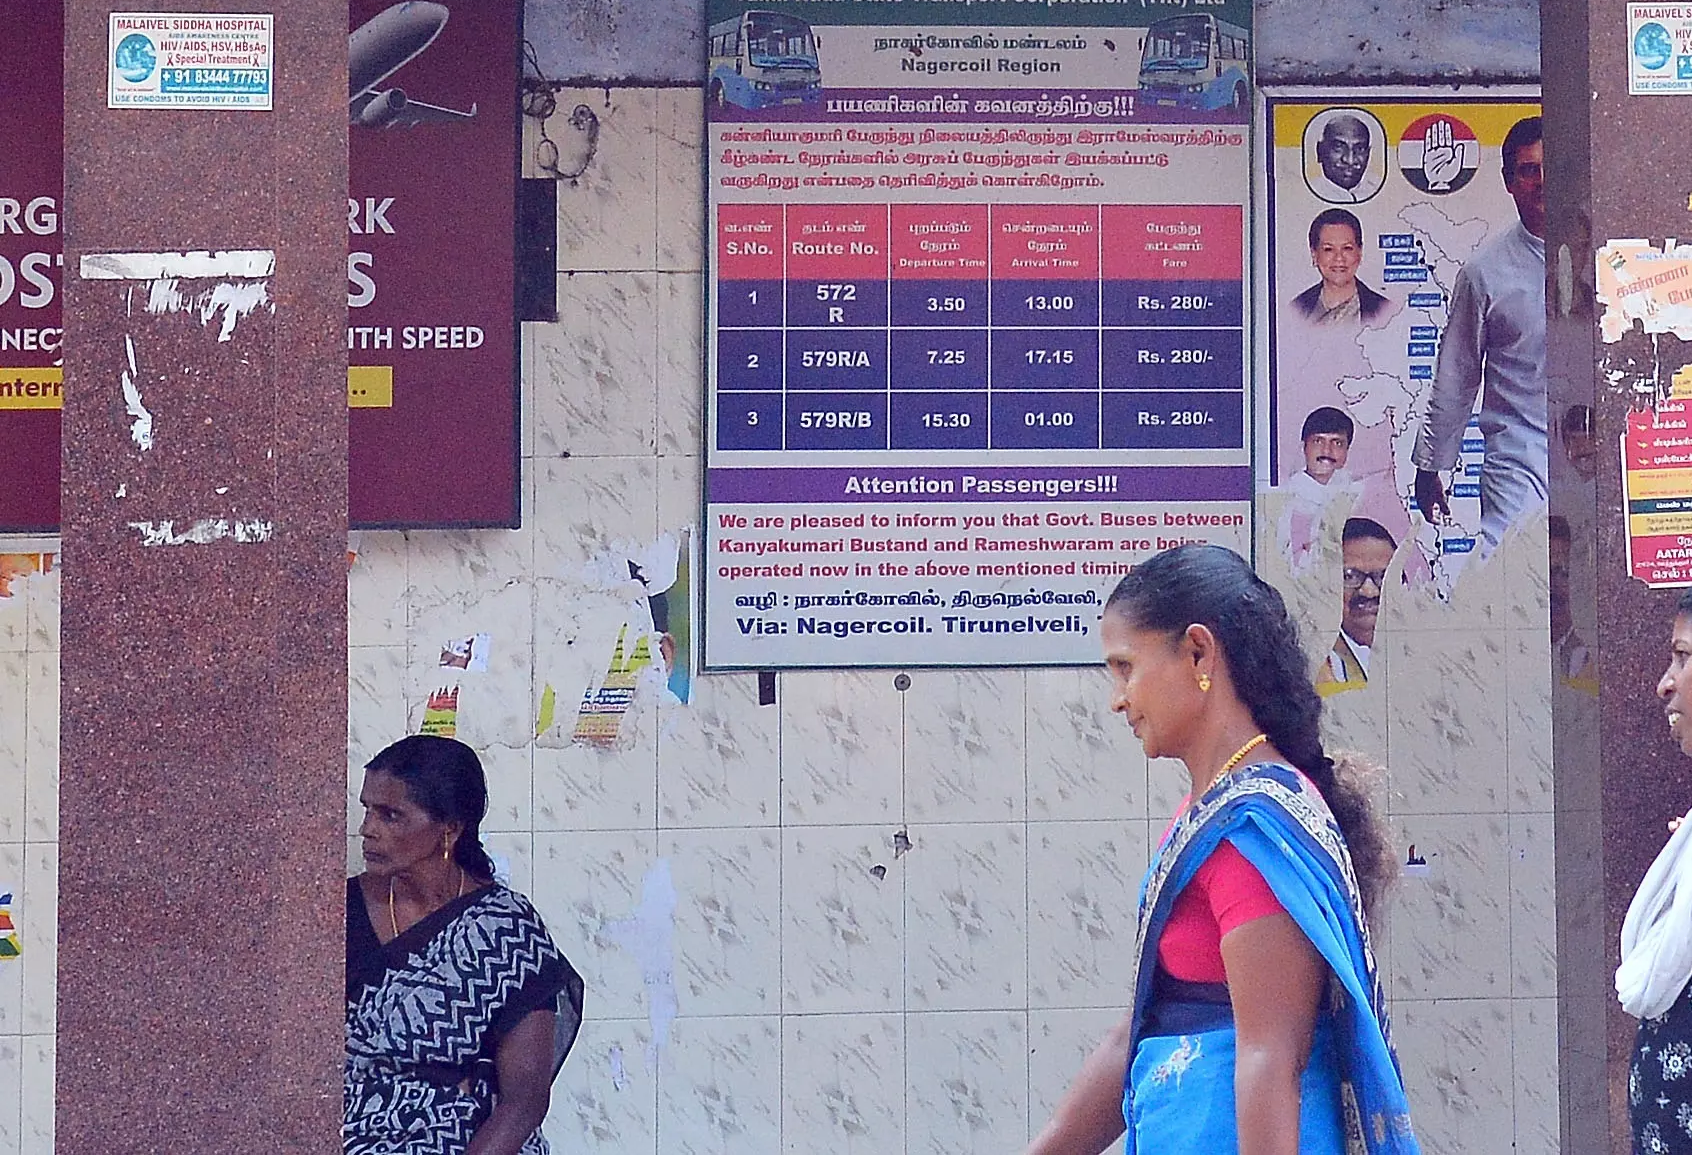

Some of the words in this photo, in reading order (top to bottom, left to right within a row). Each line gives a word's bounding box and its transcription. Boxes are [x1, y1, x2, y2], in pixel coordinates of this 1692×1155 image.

[1635, 8, 1683, 18] MALAIVEL
[117, 19, 169, 30] MALAIVEL
[173, 20, 212, 30] SIDDHA
[216, 20, 266, 30] HOSPITAL
[874, 34, 998, 52] நாகர்கோவில்
[1004, 35, 1086, 52] மண்டலம்
[176, 54, 206, 65] Special
[209, 54, 250, 64] Treatment
[901, 58, 991, 75] Nagercoil
[998, 58, 1060, 75] Region
[175, 71, 190, 83] 91
[196, 71, 229, 83] 83444
[233, 71, 267, 83] 77793
[827, 95, 967, 115] பயணிகளின்
[720, 127, 842, 144] கன்னியாகுமரி
[846, 127, 915, 146] பேருந்து
[963, 150, 1060, 167] பேருந்துகள்
[720, 172, 799, 189] வருகிறது
[803, 172, 874, 188] என்பதை
[726, 242, 773, 255] S.No.
[792, 242, 844, 255] Route
[850, 242, 879, 255] No.
[900, 258, 955, 269] Departure
[958, 258, 985, 267] Time
[1012, 258, 1048, 267] Arrival
[1053, 258, 1079, 267] Time
[1163, 258, 1187, 267] Fare
[749, 292, 758, 304] 1
[816, 285, 856, 301] 572
[927, 297, 965, 311] 3.50
[1025, 296, 1073, 310] 13.00
[1138, 296, 1165, 310] Rs.
[1172, 296, 1213, 311] 280/-
[829, 307, 844, 323] R
[348, 327, 392, 349] ITH
[403, 327, 484, 349] SPEED
[747, 355, 758, 368] 2
[802, 350, 870, 368] 579R/A
[927, 351, 965, 365] 7.25
[1025, 351, 1073, 364] 17.15
[1138, 350, 1165, 363] Rs.
[1172, 349, 1213, 365] 280/-
[748, 412, 758, 426] 3
[800, 412, 871, 429] 579R/B
[922, 413, 970, 427] 15.30
[1025, 413, 1073, 426] 01.00
[1138, 412, 1165, 426] Rs.
[1172, 412, 1213, 426] 280/-
[845, 477, 953, 493] Attention
[962, 476, 1118, 497] Passengers!!!
[719, 514, 748, 528] We
[754, 517, 784, 528] are
[791, 513, 865, 531] pleased
[872, 515, 889, 528] to
[896, 513, 956, 528] inform
[962, 517, 995, 531] you
[1002, 513, 1040, 527] that
[1046, 513, 1093, 527] Govt.
[1101, 513, 1157, 527] Buses
[1163, 512, 1243, 527] between
[719, 538, 844, 556] Kanyakumari
[851, 538, 927, 552] Bustand
[934, 537, 968, 552] and
[975, 537, 1114, 551] Rameshwaram
[1120, 540, 1150, 551] are
[719, 562, 802, 580] operated
[809, 566, 848, 577] now
[855, 562, 872, 576] in
[878, 562, 908, 576] the
[914, 561, 969, 576] above
[976, 561, 1074, 575] mentioned
[1081, 561, 1136, 575] timin
[735, 591, 777, 611] வழி
[737, 618, 787, 635] Via:
[942, 615, 1087, 636] Tirunelveli,
